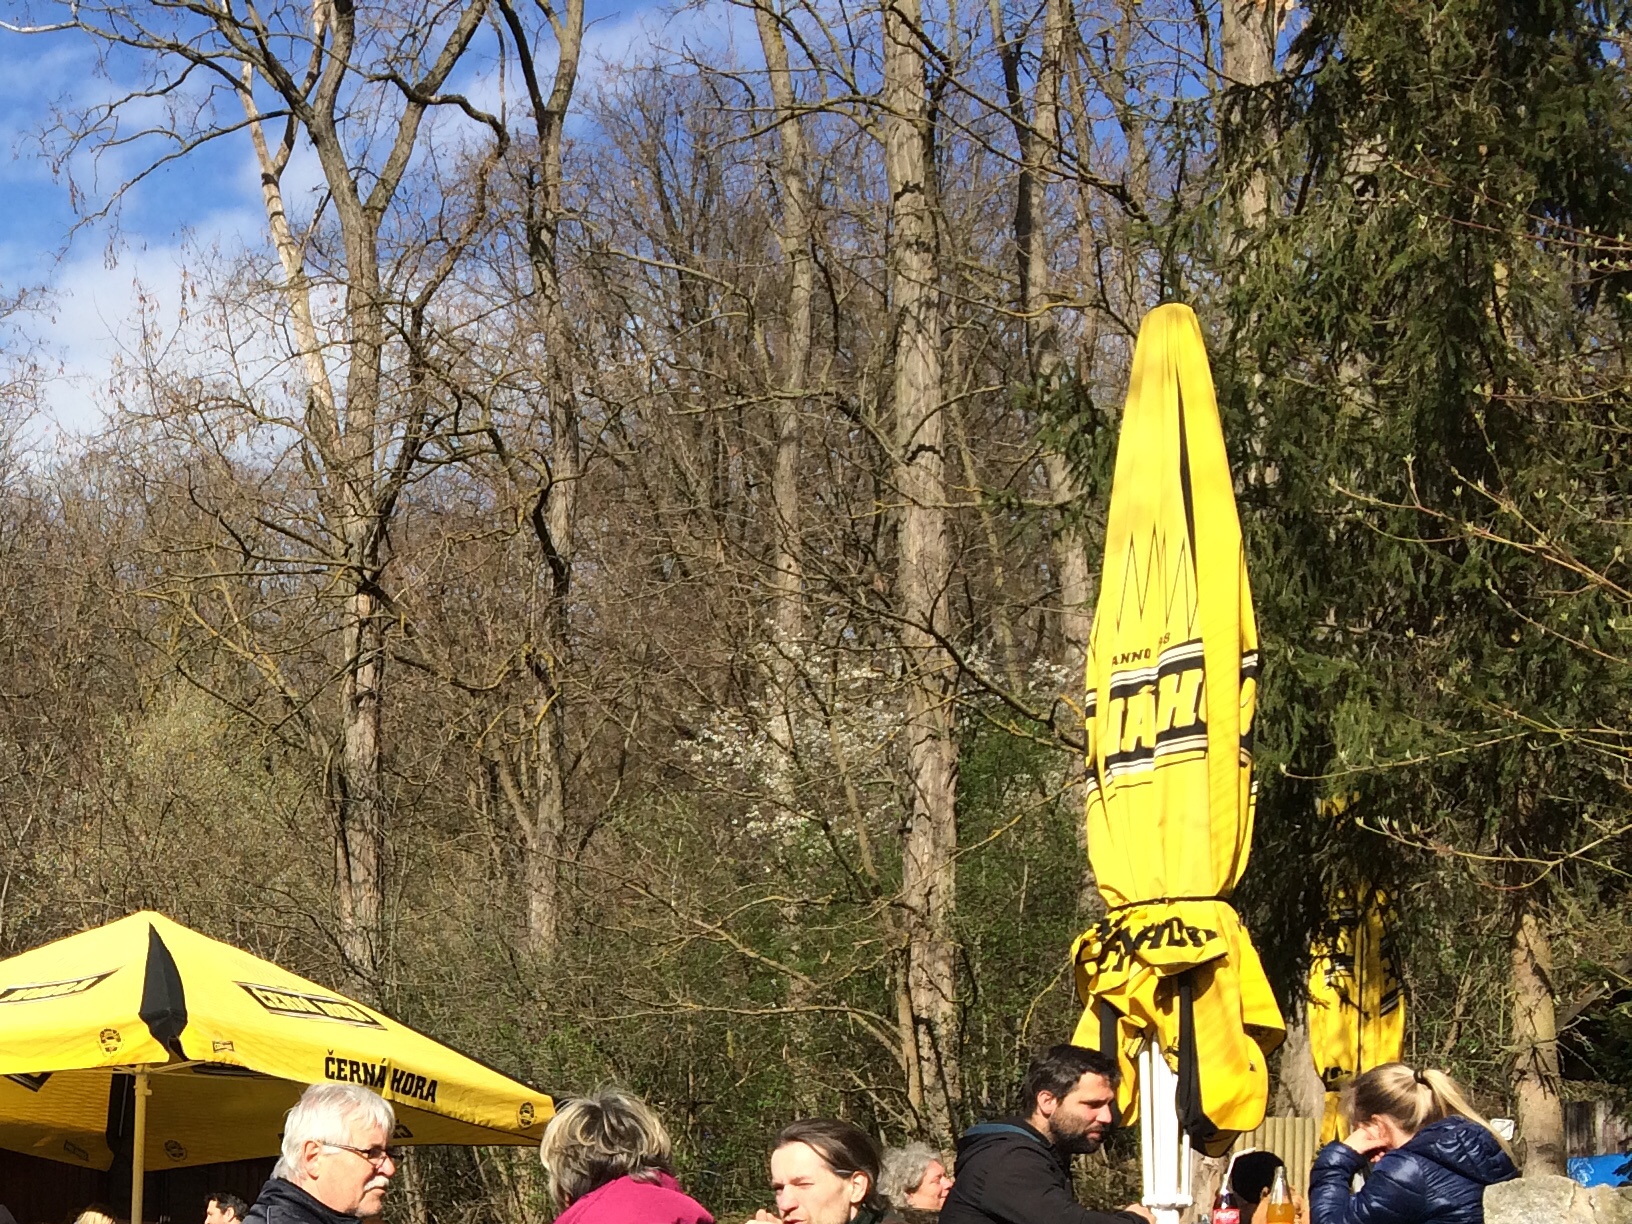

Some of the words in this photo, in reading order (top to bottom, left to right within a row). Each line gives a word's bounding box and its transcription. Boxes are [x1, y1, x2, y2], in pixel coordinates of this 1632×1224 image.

[1112, 647, 1151, 666] ANNO
[324, 1048, 388, 1088] ČERNÁ
[390, 1067, 439, 1104] HORA
